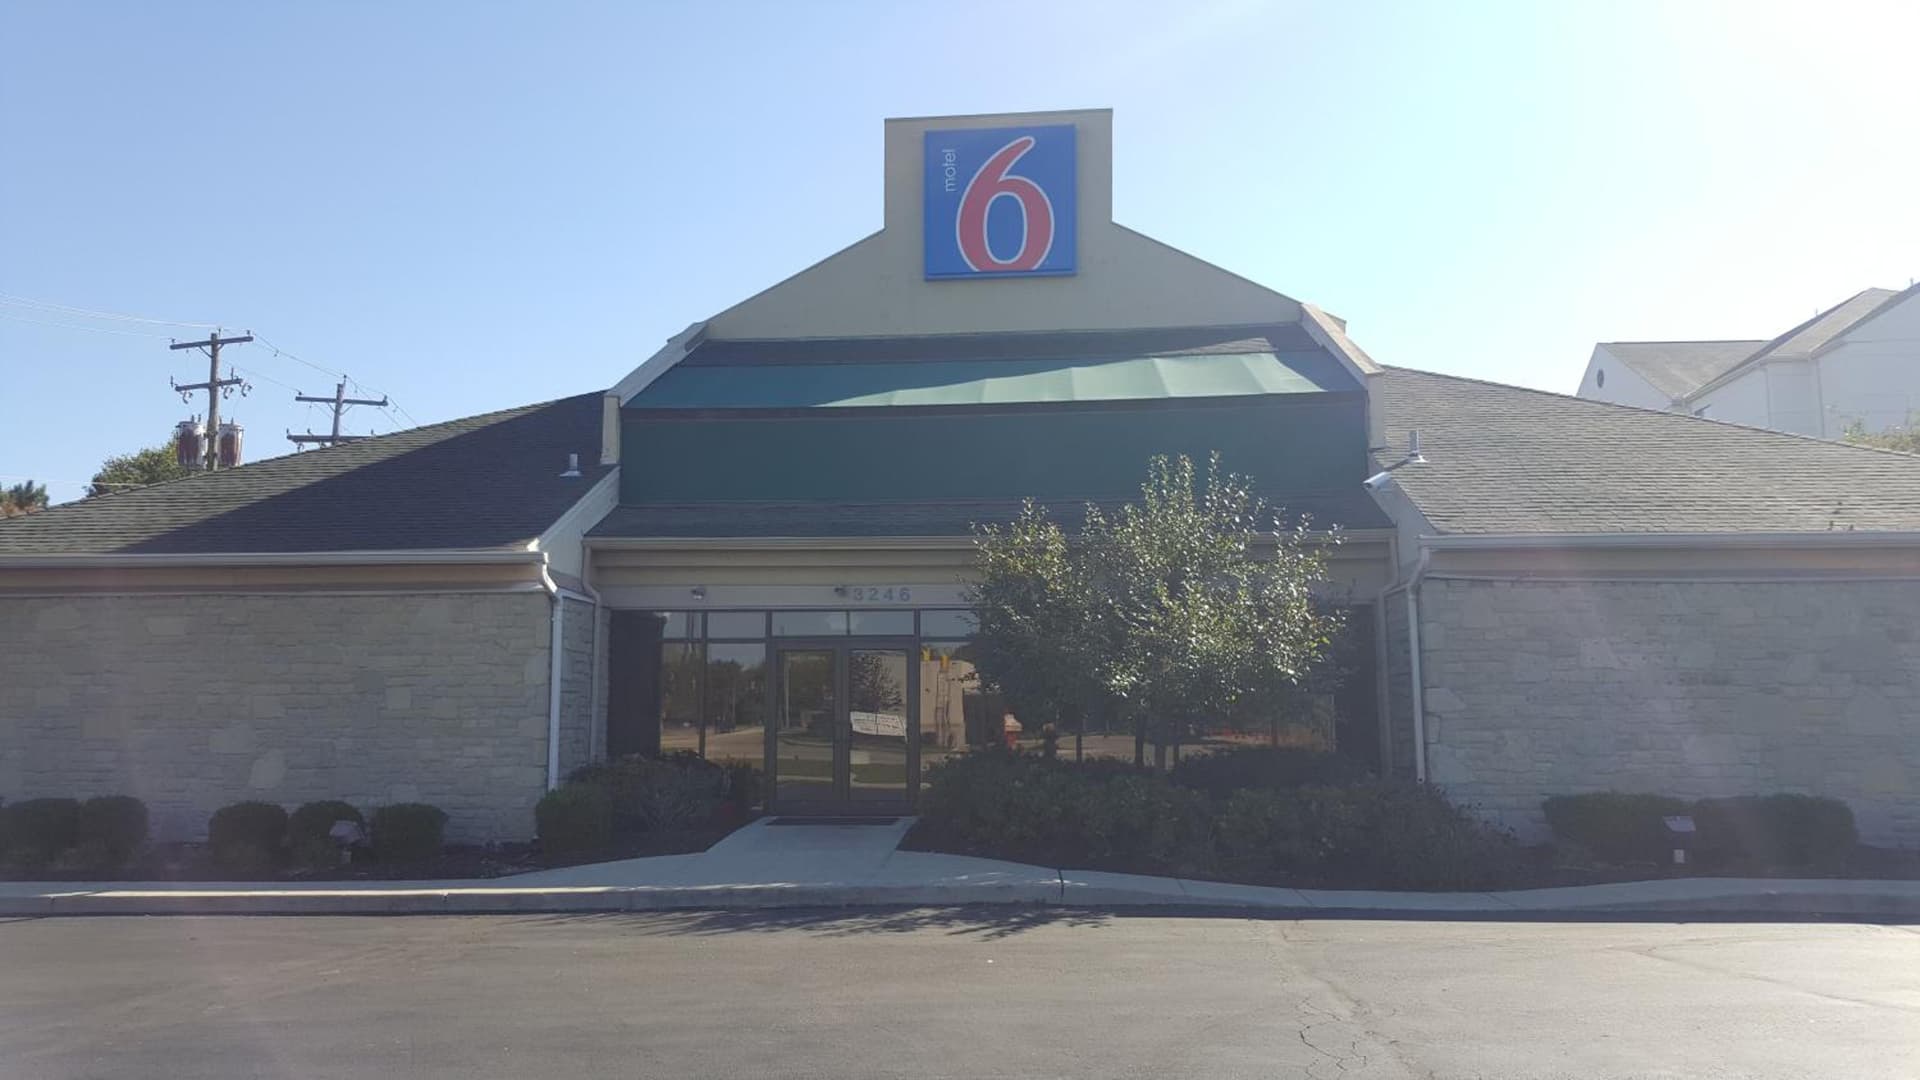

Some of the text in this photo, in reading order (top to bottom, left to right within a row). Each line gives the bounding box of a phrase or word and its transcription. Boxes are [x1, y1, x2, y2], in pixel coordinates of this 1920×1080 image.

[942, 149, 956, 192] motel
[956, 136, 1055, 272] 6
[853, 587, 911, 601] 3246
